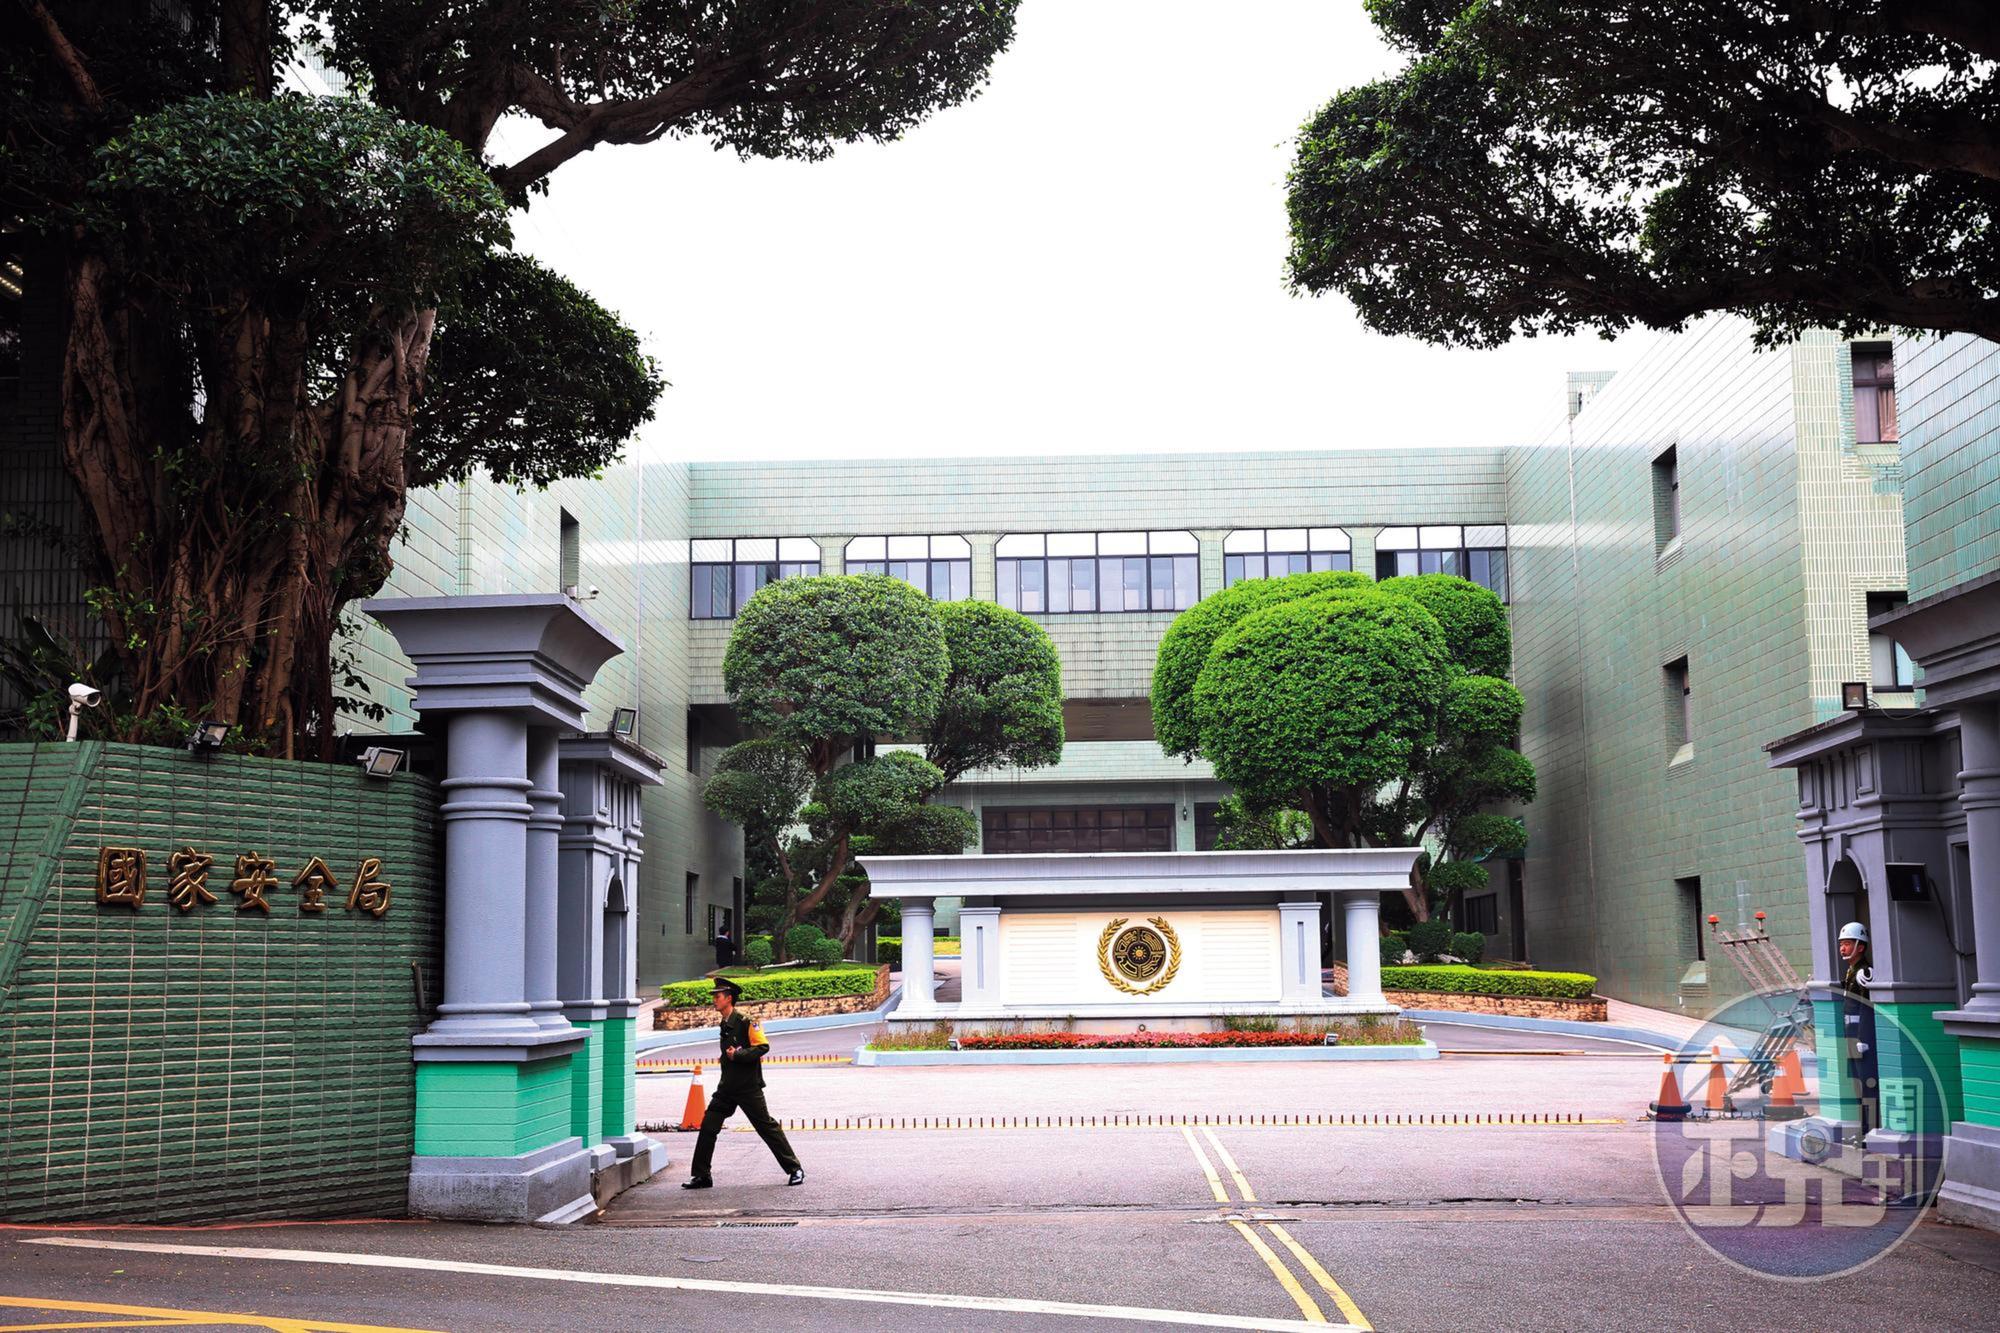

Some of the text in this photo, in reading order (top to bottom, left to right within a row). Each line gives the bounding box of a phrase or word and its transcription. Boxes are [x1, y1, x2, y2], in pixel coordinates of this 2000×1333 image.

[98, 846, 391, 915] 國家安全局
